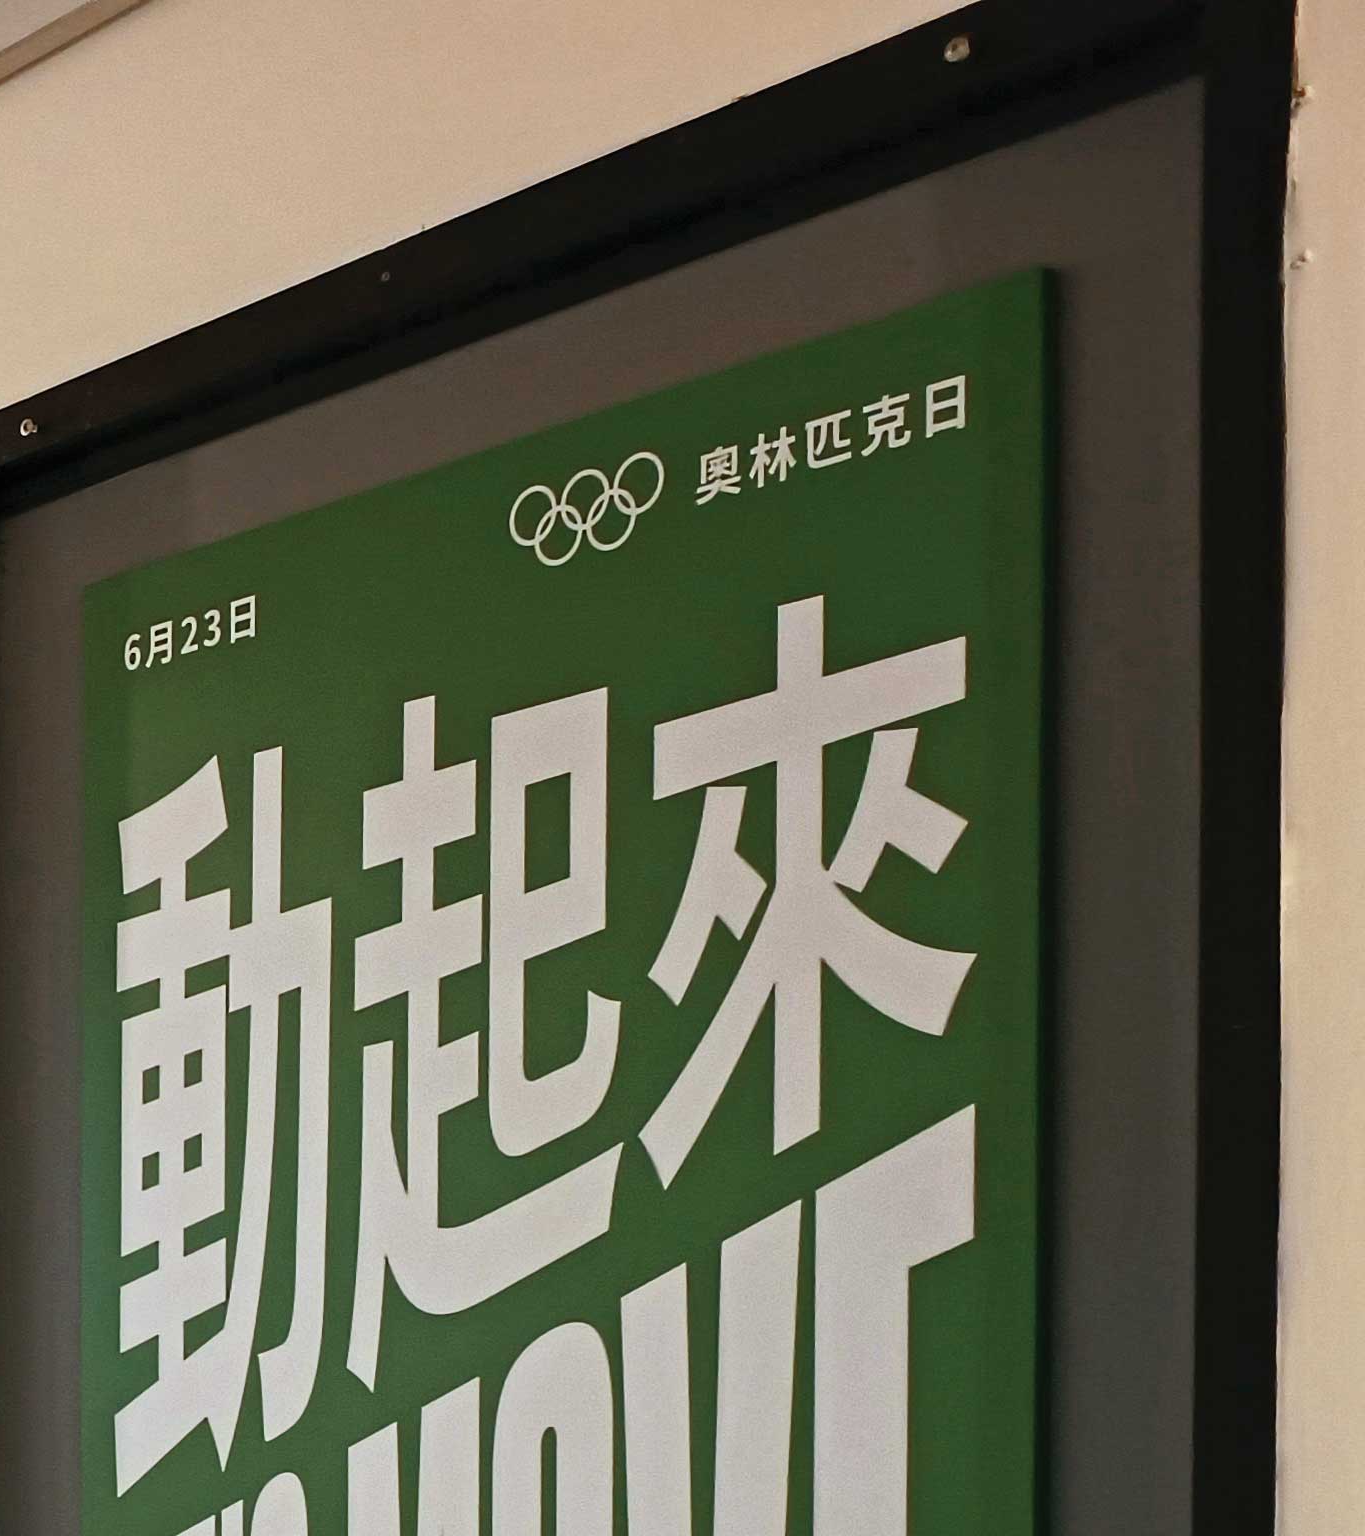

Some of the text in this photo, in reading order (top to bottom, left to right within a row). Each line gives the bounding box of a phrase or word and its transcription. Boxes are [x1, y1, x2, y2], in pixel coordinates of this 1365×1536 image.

[695, 375, 966, 506] 奧林匹克日
[124, 594, 256, 671] 6月23日
[114, 595, 978, 1498] 動起來
